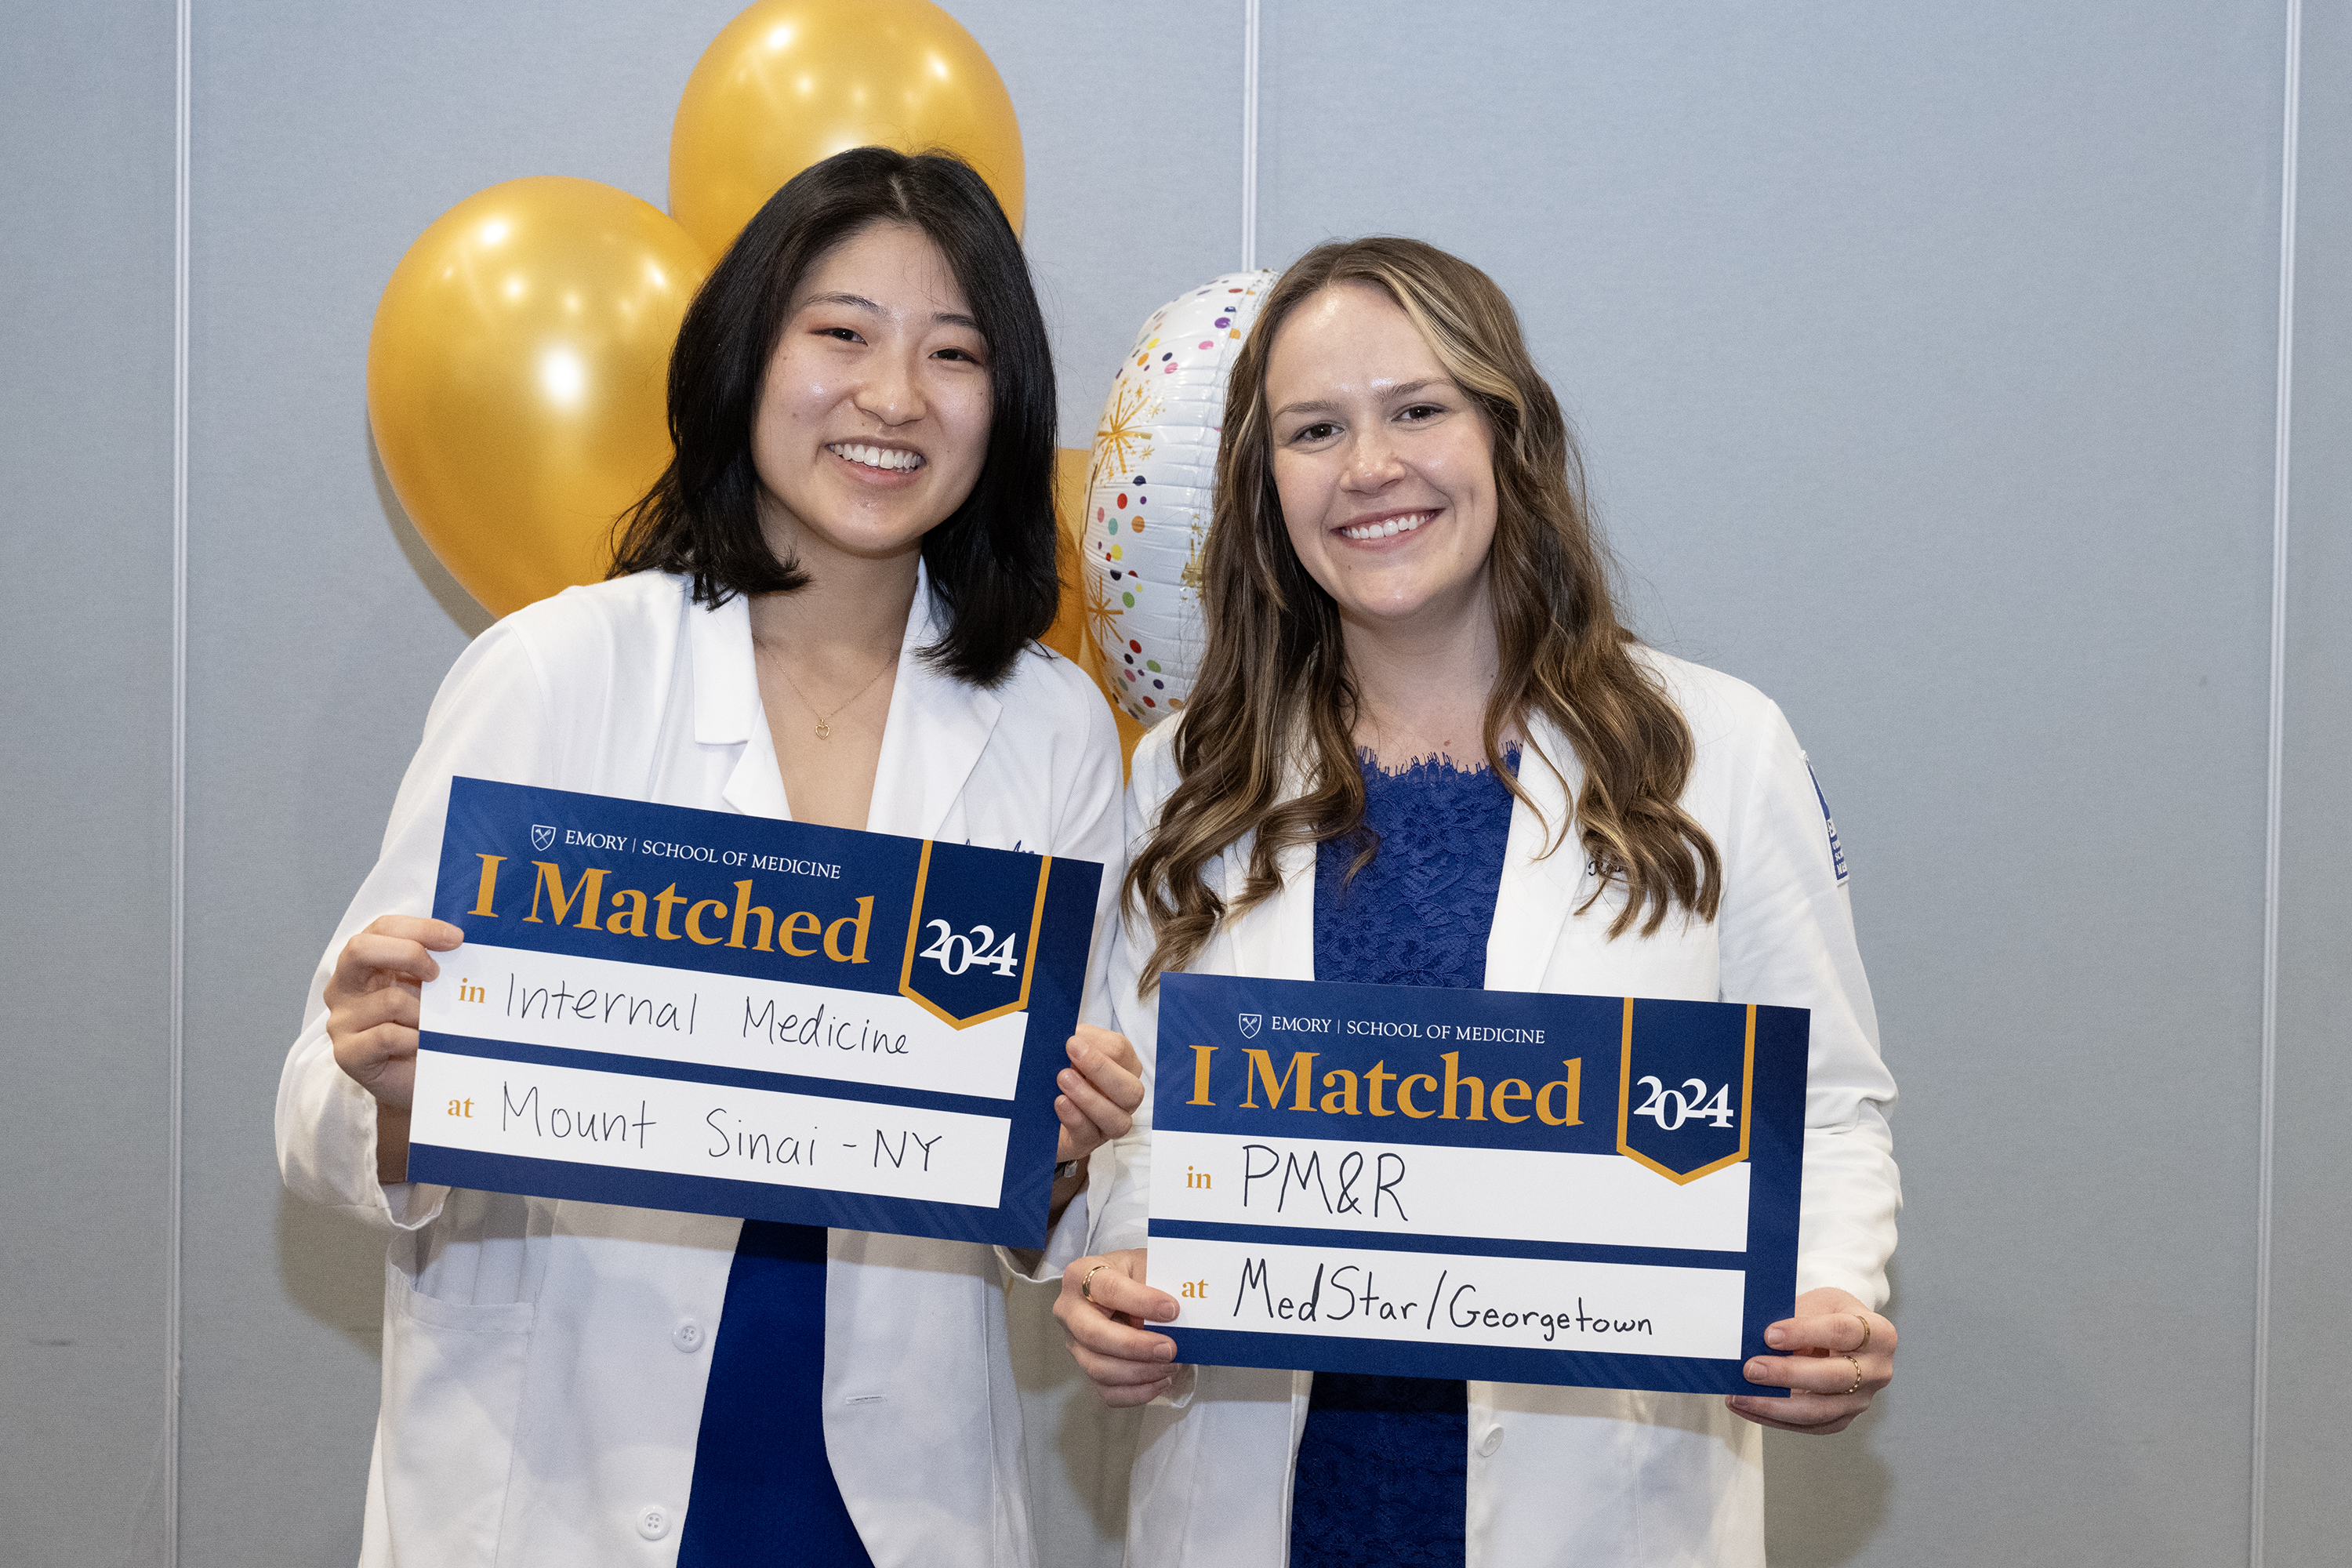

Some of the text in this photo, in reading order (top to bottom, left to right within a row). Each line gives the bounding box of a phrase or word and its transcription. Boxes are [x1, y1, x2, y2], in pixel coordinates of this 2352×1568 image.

[564, 829, 841, 880] EMORY SCHOOL OF MEDICINE
[467, 853, 874, 964] I Matched
[919, 919, 1018, 977] 2024
[459, 978, 485, 1004] in
[507, 973, 909, 1054] Internal Medicine
[1272, 1015, 1545, 1044] EMORY SCHOOL OF MEDICINE
[448, 1098, 474, 1118] at
[1185, 1045, 1584, 1127] I Matched
[1633, 1075, 1734, 1131] 2024
[503, 1081, 656, 1149] Mount
[706, 1108, 815, 1166] Sinai
[1187, 1165, 1211, 1189] in
[1242, 1144, 1409, 1221] PM&R
[1181, 1279, 1209, 1299] at
[1232, 1258, 1653, 1341] MedStar/Georgetown
